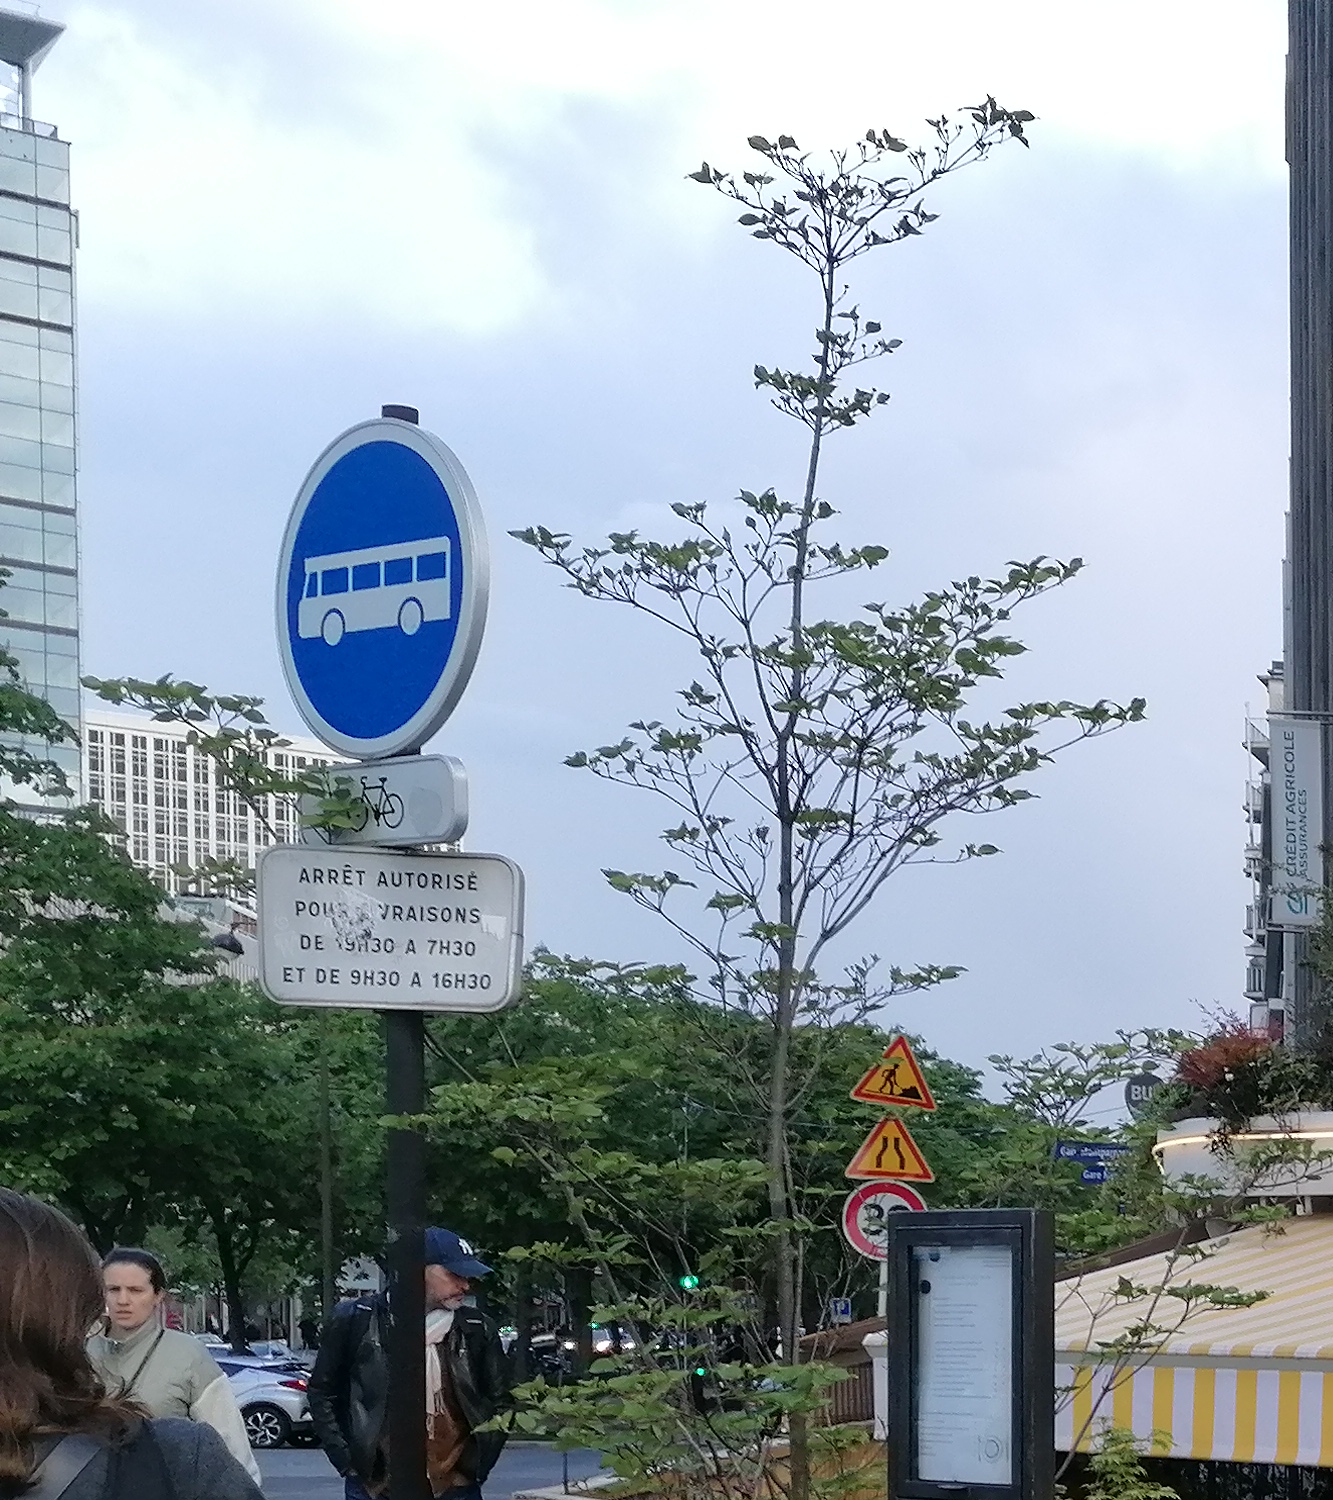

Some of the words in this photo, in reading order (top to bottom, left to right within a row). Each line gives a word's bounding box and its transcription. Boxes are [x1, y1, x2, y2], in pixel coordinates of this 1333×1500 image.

[1284, 731, 1296, 813] AGRICOLE
[1284, 816, 1297, 877] CRÉDIT
[1298, 789, 1308, 879] ASSURANCES
[299, 864, 366, 886] ARRÊT
[377, 870, 479, 891] AUTORISÉ
[295, 900, 347, 919] POU
[355, 902, 481, 924] VRAISONS
[300, 934, 325, 951] DE
[405, 941, 417, 955] A
[427, 939, 476, 956] 7H30
[283, 966, 305, 983] ET
[316, 968, 340, 985] DE
[350, 970, 400, 987] 9H30
[410, 972, 422, 988] A
[432, 973, 492, 990] 16H30
